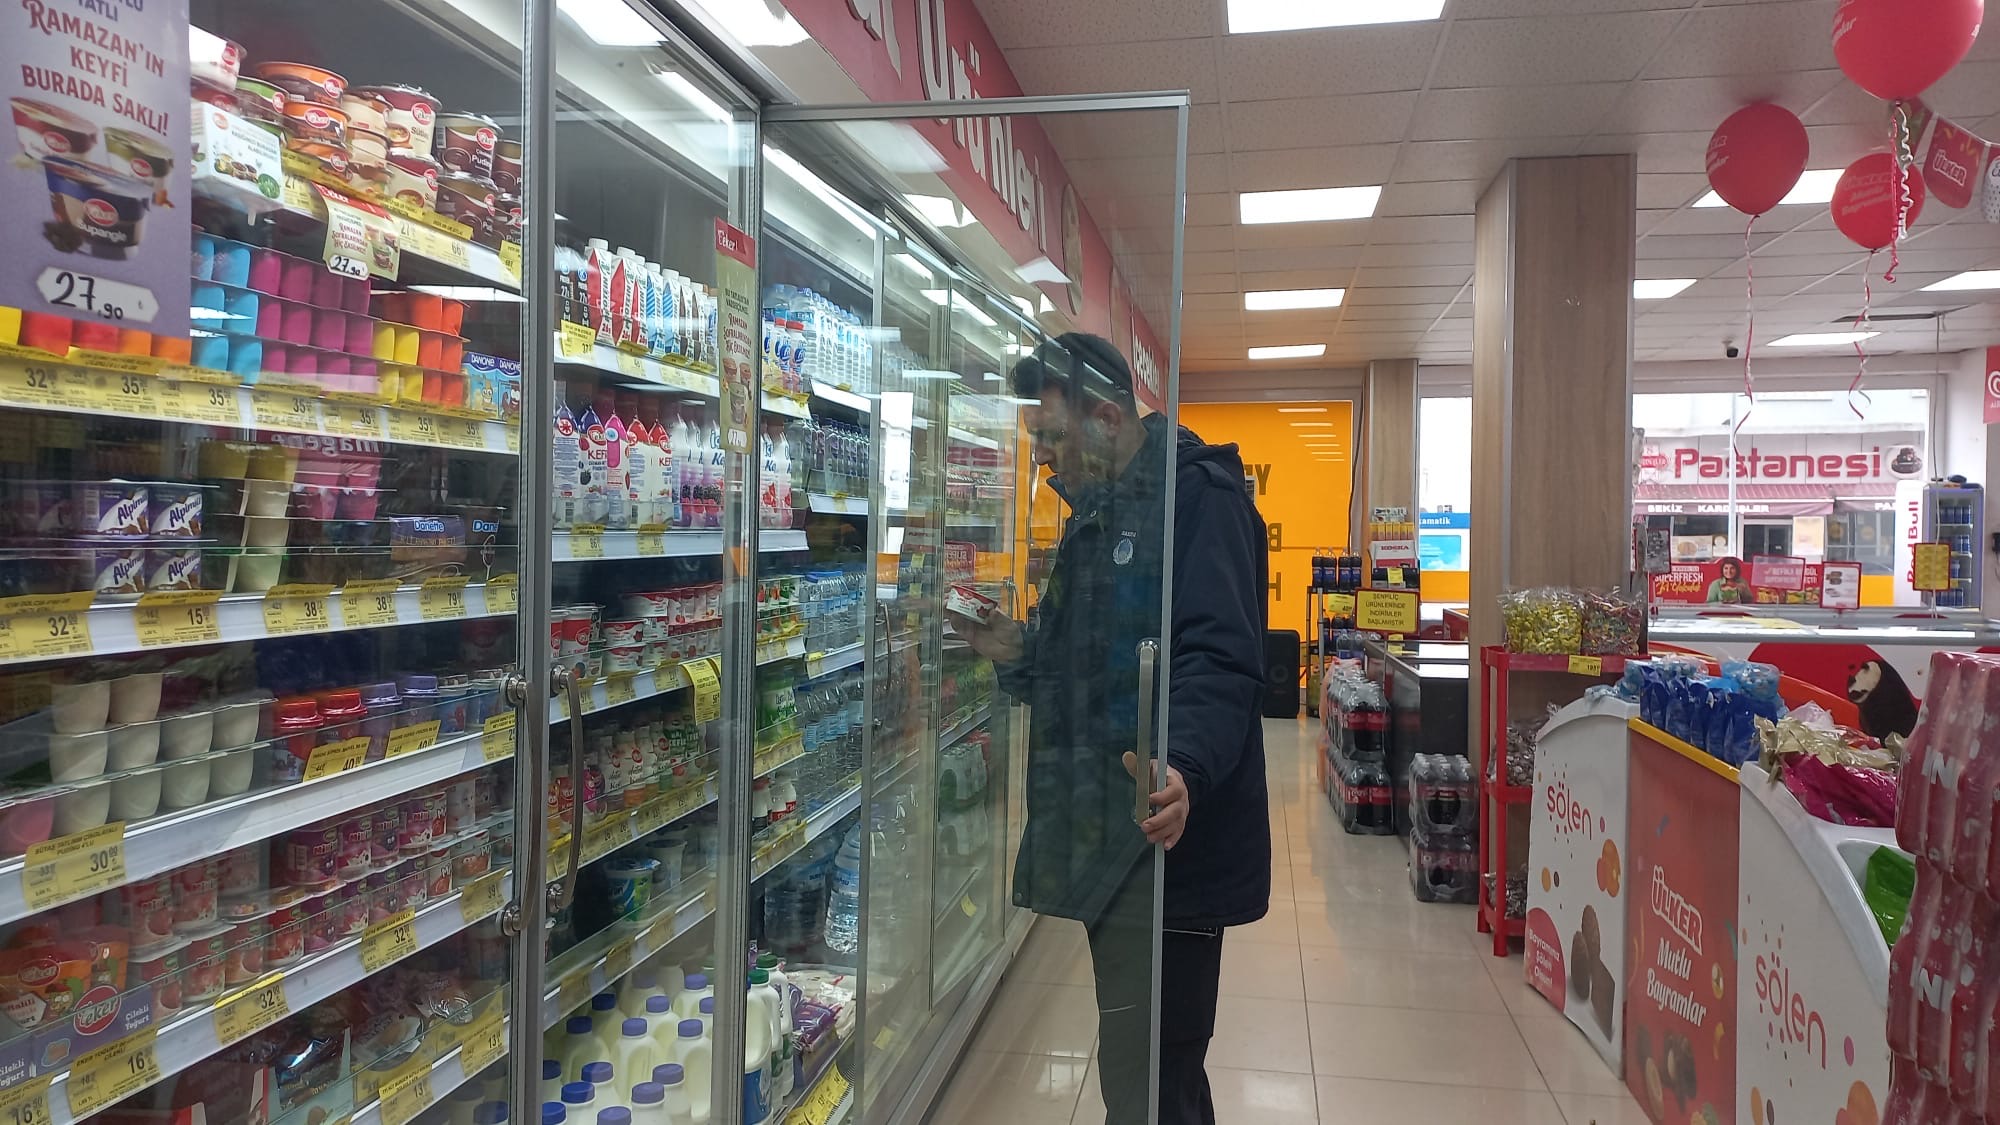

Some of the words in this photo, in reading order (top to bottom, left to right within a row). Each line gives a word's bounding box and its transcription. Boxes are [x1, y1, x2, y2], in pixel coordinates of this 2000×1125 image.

[69, 46, 128, 87] KEYFİ
[21, 64, 104, 107] BURADA
[113, 93, 168, 136] SAKLI!
[1932, 149, 1967, 186] ÜLKER
[24, 368, 48, 389] 32
[121, 376, 140, 395] 35
[208, 387, 225, 406] 35
[360, 408, 372, 425] 35
[417, 417, 430, 431] 35
[1674, 446, 1880, 479] Pastanesi
[1697, 504, 1770, 514] KARDŞLER
[413, 518, 445, 533] Danette
[1908, 501, 1919, 539] Bull
[187, 608, 203, 625] 15
[304, 602, 318, 617] 38
[48, 616, 69, 637] 32
[90, 849, 109, 873] 30
[1651, 864, 1703, 956] ÜLKER
[395, 926, 405, 944] 32
[1657, 937, 1692, 981] Mutlu
[258, 990, 273, 1009] 32
[1646, 967, 1707, 1027] Bayramlar
[127, 1051, 145, 1074] 16
[12, 1104, 33, 1125] 16
